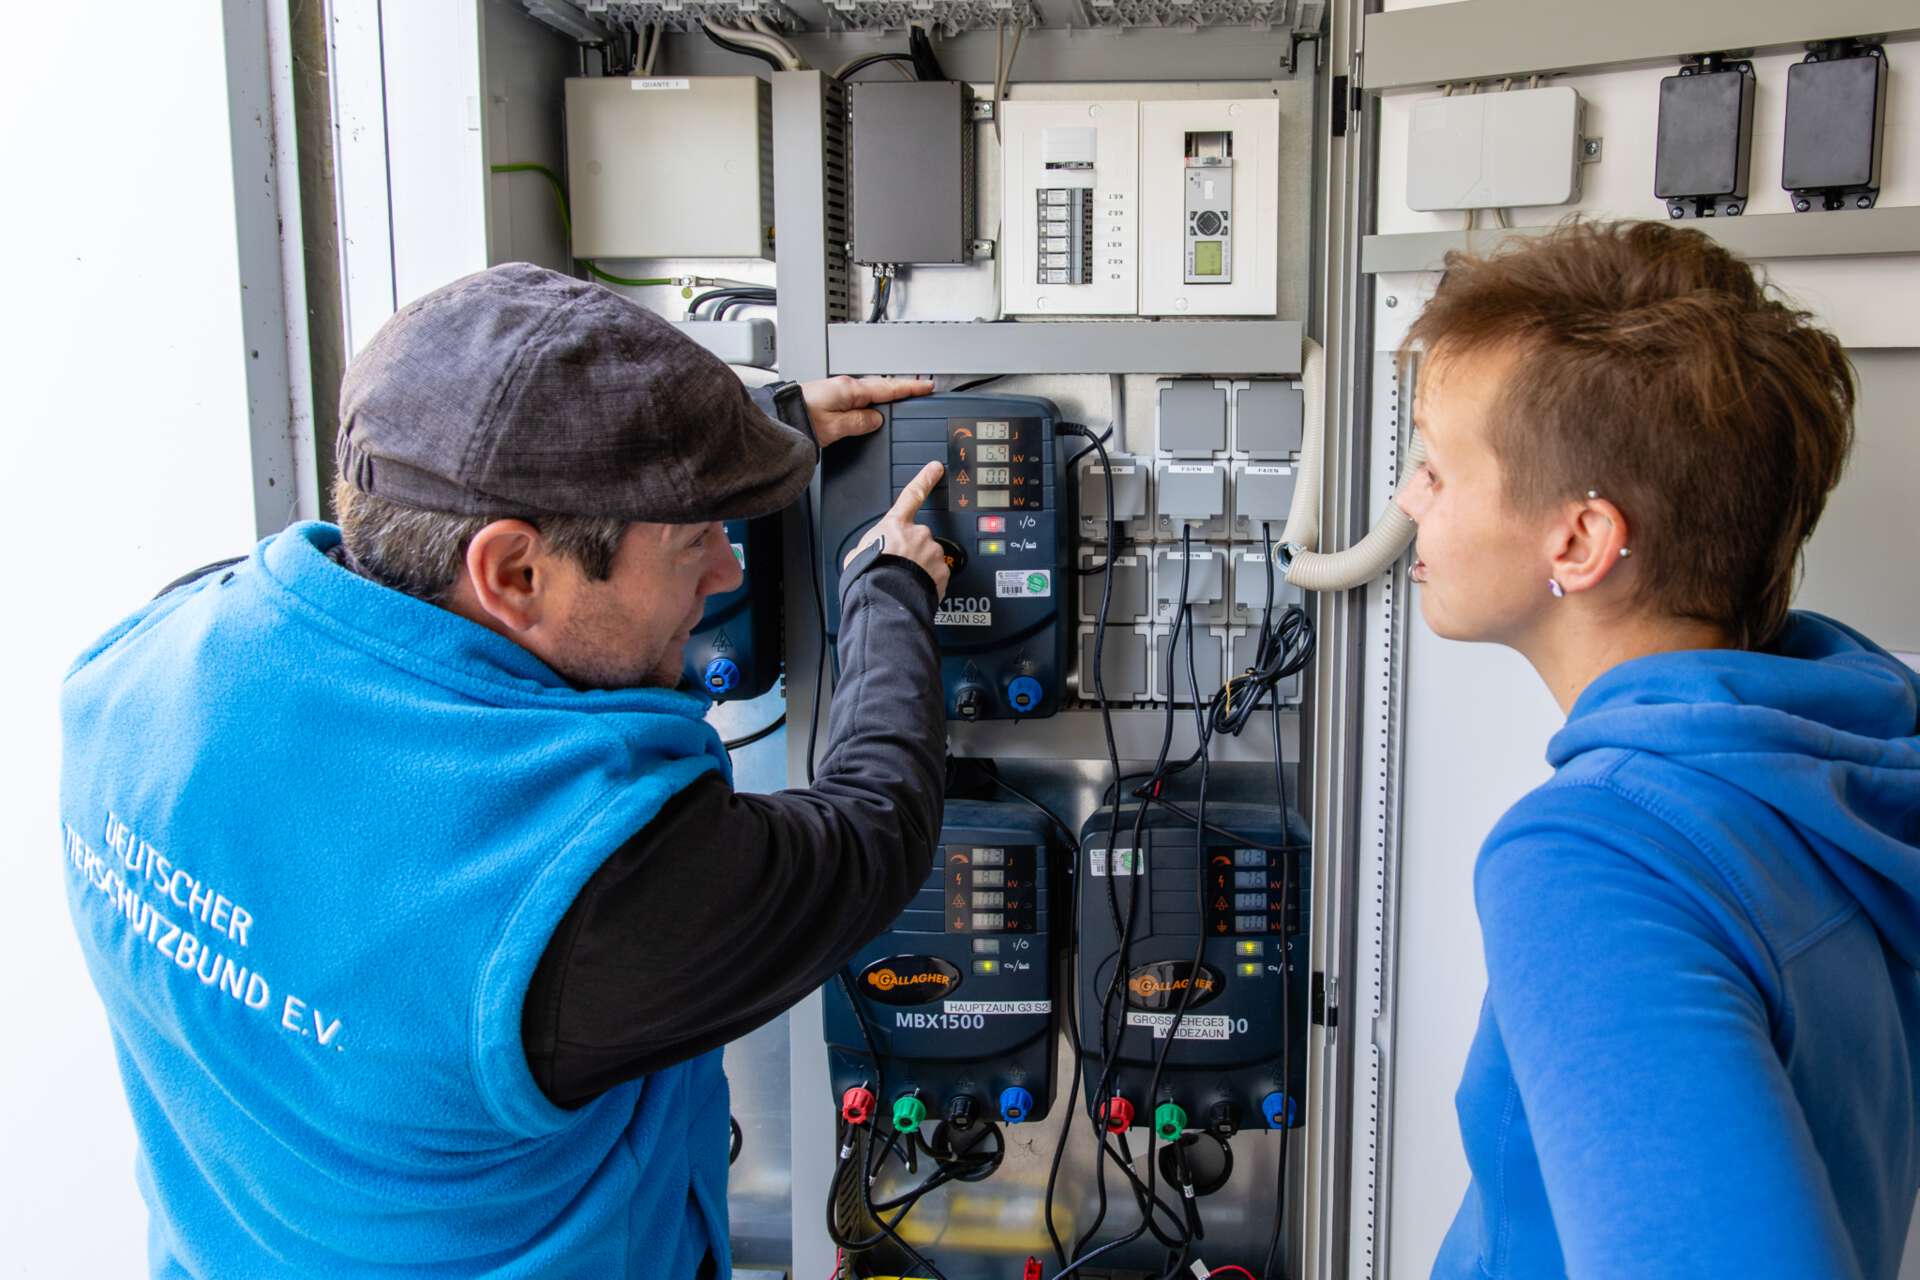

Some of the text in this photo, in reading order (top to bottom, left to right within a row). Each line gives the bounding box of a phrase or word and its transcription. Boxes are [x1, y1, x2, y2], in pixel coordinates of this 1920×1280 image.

[1012, 454, 1025, 463] kV
[1012, 476, 1025, 486] kV
[1012, 497, 1025, 506] kV
[943, 596, 991, 612] 1500
[972, 614, 987, 624] S2
[105, 810, 254, 947] DEUTSCHER
[63, 822, 345, 1052] TIERSCHUTZBUND E.V.
[879, 971, 951, 986] GALLAGHER
[950, 1002, 1049, 1013] HAUPTZAUN G3 S2
[896, 1012, 985, 1030] MBX1500
